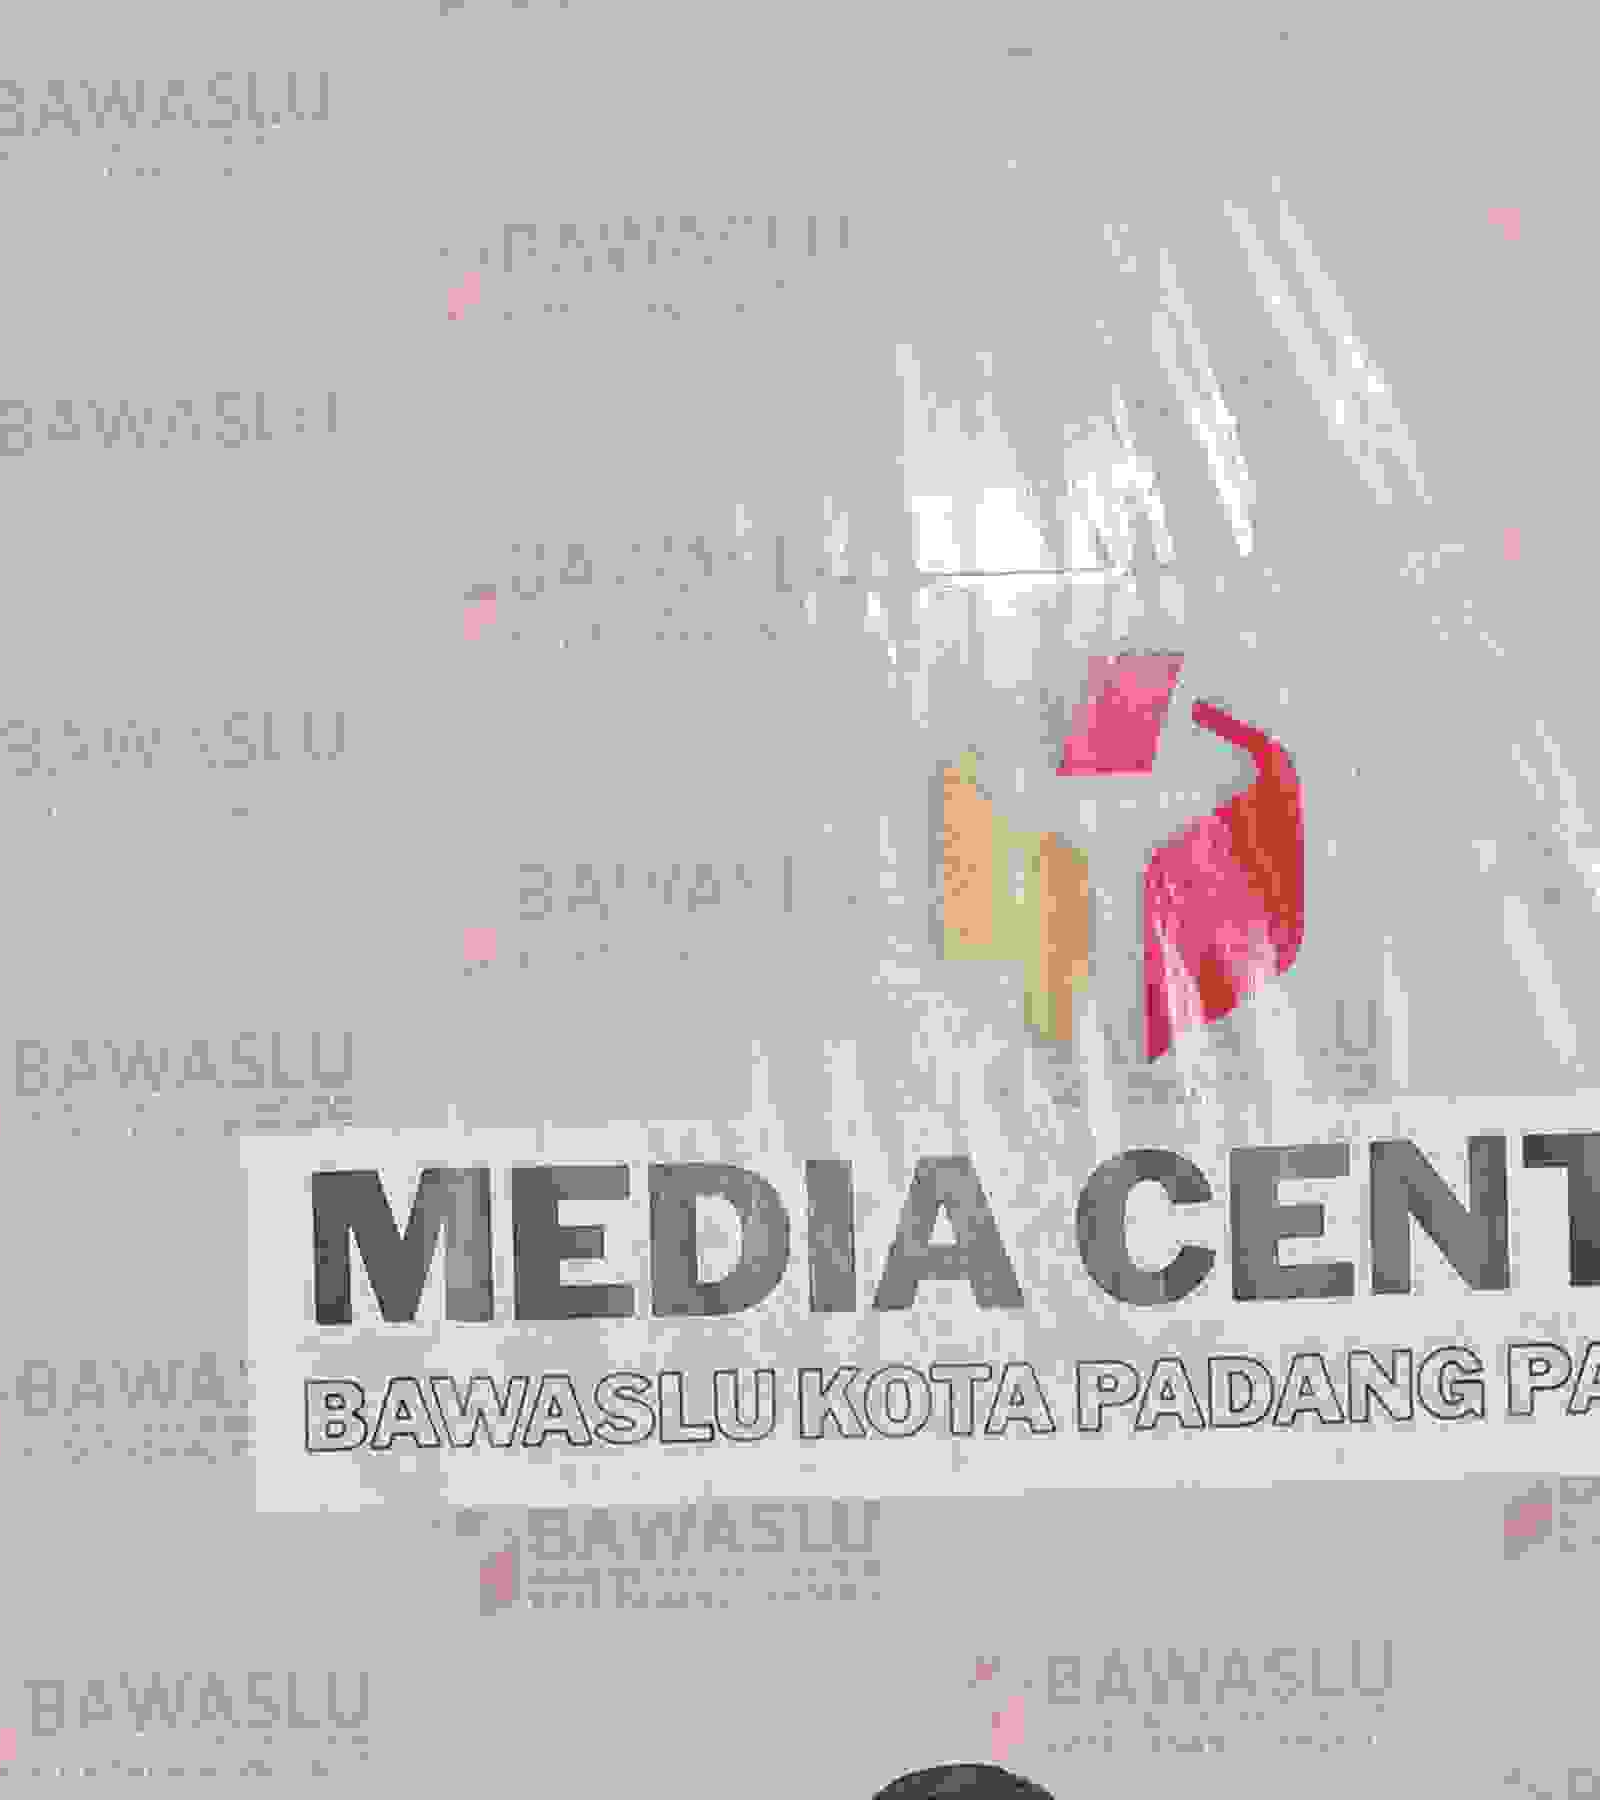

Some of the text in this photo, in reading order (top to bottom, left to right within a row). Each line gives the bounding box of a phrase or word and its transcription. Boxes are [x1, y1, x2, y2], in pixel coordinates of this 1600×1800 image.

[13, 1031, 354, 1097] BAWASLU
[311, 1154, 1026, 1326] MEDIA
[304, 1367, 778, 1454] BAWASLU
[799, 1360, 1057, 1441] KOTA
[1076, 1346, 1486, 1433] PADANG
[22, 1671, 370, 1738] BAWASLU
[1046, 1640, 1394, 1706] BAWASLU
